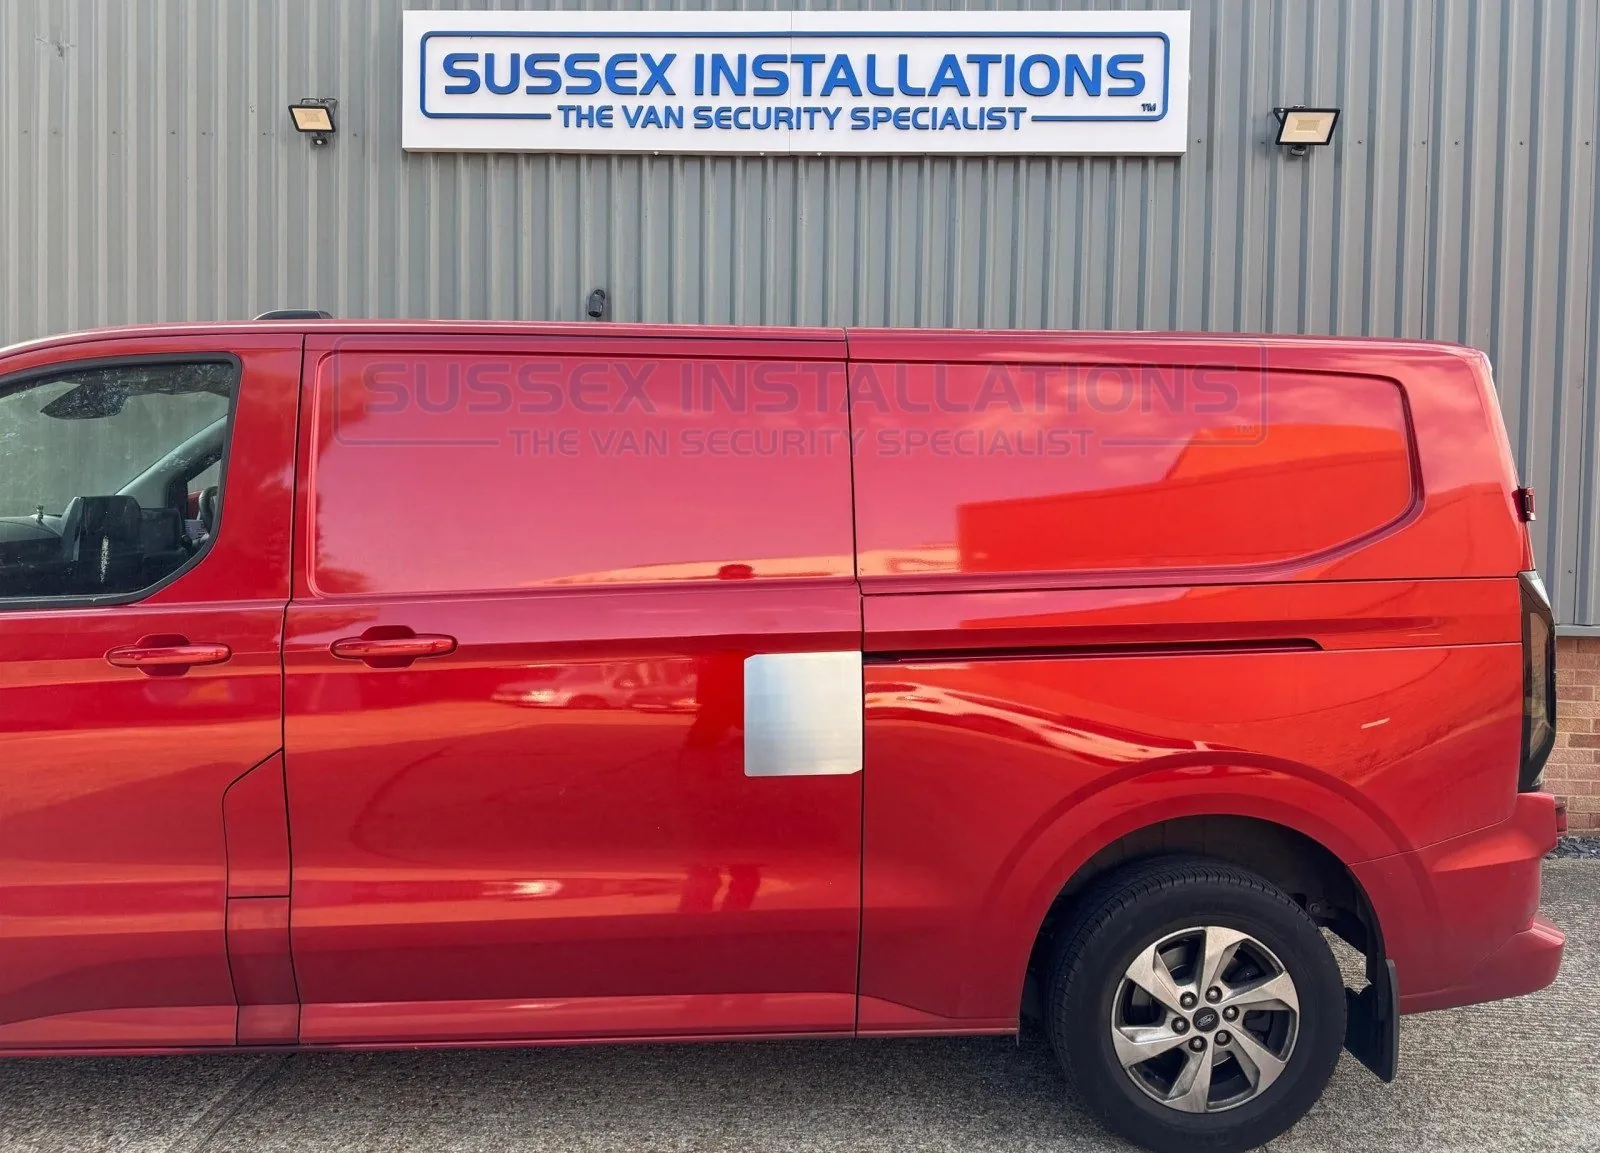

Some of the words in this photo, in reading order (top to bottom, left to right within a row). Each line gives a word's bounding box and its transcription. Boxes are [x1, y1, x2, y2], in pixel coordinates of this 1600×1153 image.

[443, 53, 676, 96] SUSSEX
[694, 53, 1146, 97] INSTALLATIONS
[558, 105, 613, 128] THE
[622, 105, 684, 129] VAN
[693, 106, 841, 130] SECURITY
[851, 107, 1026, 130] SPECIALIST
